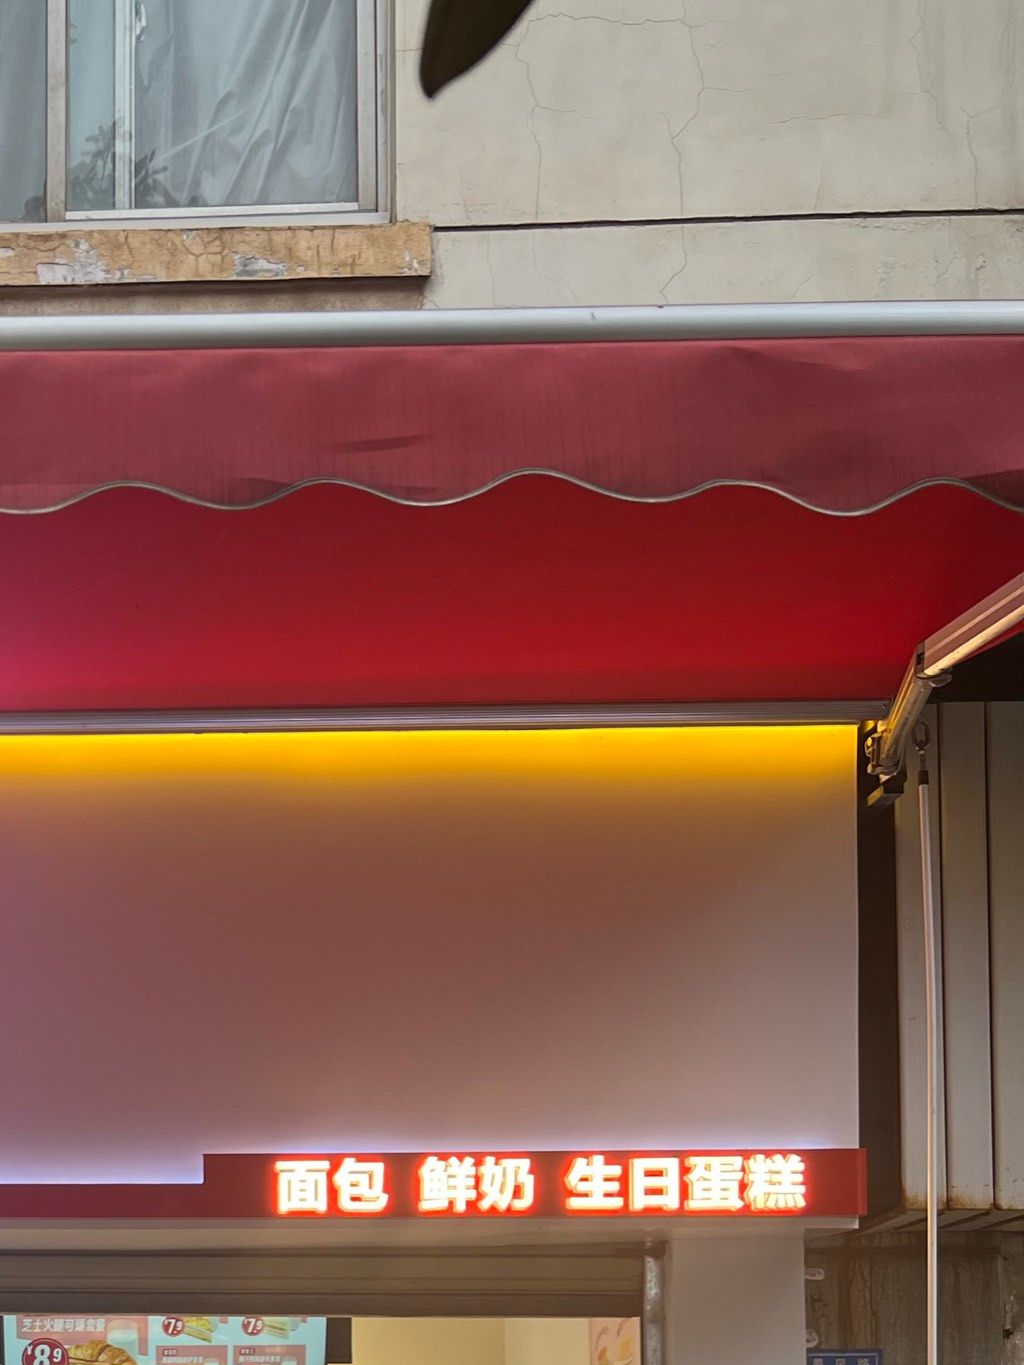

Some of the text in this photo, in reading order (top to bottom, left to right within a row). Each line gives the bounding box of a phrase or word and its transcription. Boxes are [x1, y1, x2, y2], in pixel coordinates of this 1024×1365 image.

[276, 1155, 807, 1213] 面包 鲜奶 生日蛋糕
